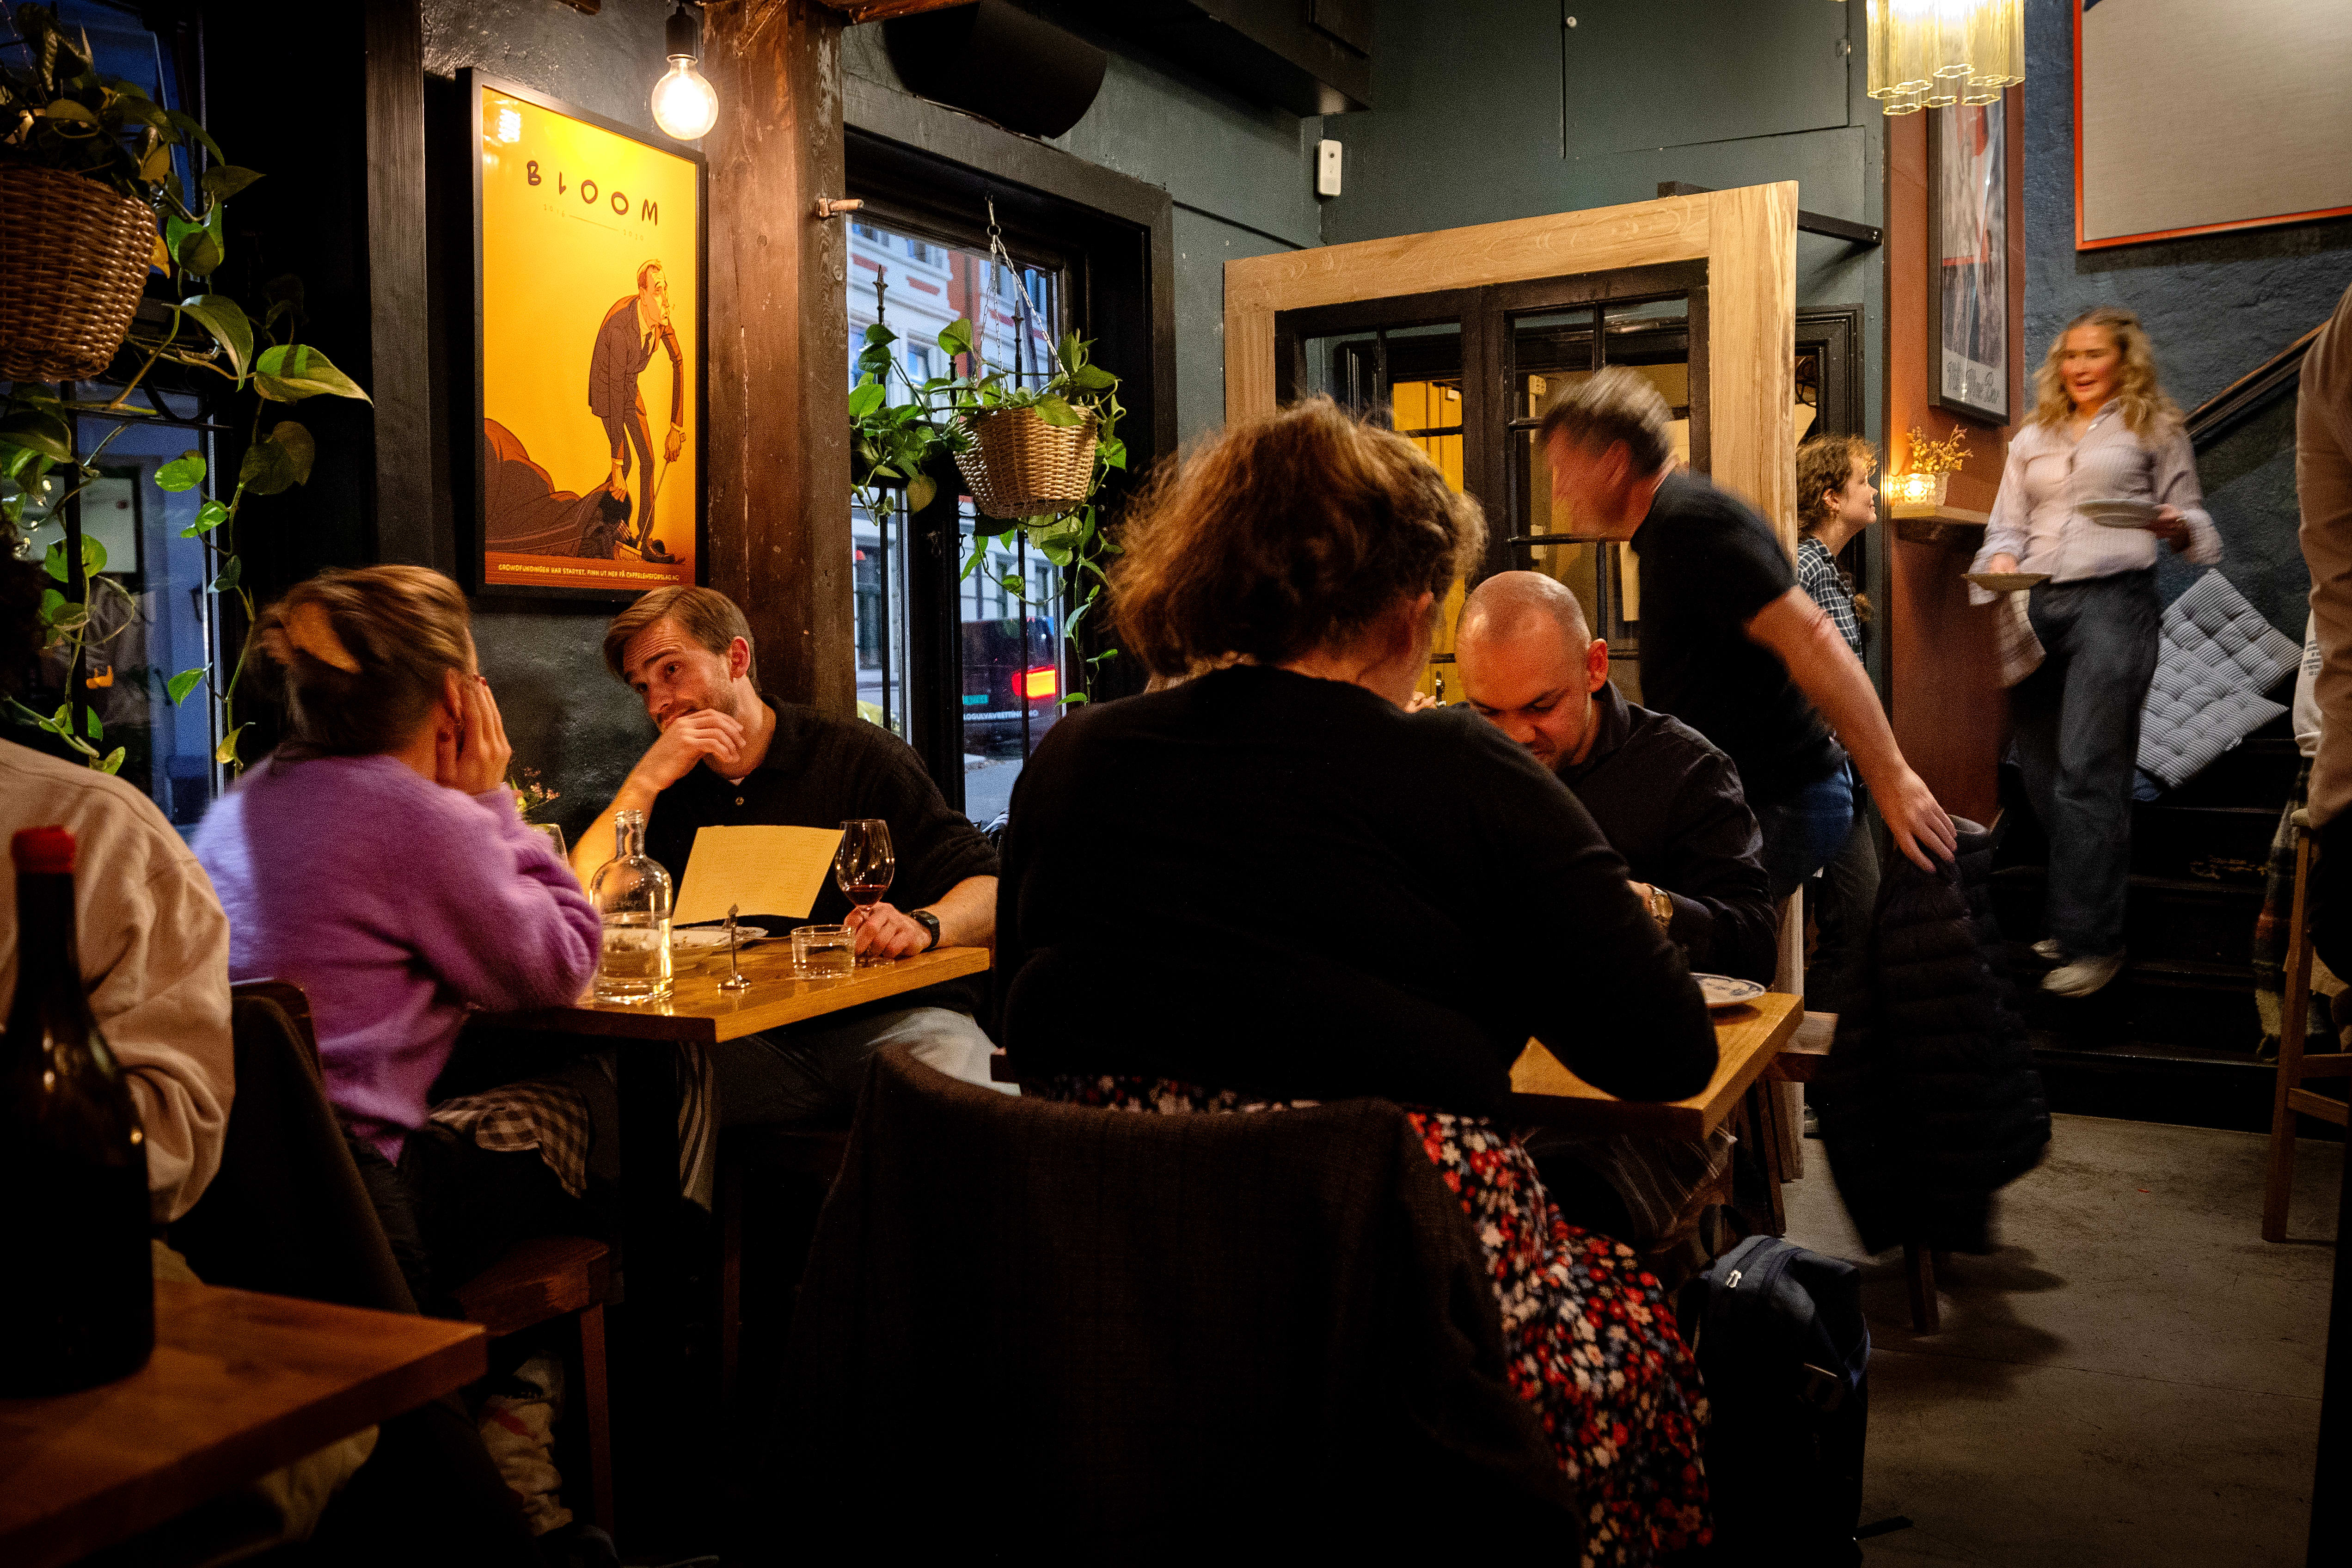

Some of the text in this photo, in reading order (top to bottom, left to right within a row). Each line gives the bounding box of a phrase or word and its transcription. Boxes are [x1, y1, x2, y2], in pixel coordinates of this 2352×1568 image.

[527, 160, 658, 226] BLOOM
[544, 204, 565, 217] 2016
[498, 564, 550, 573] CROWDFUNDINGEN
